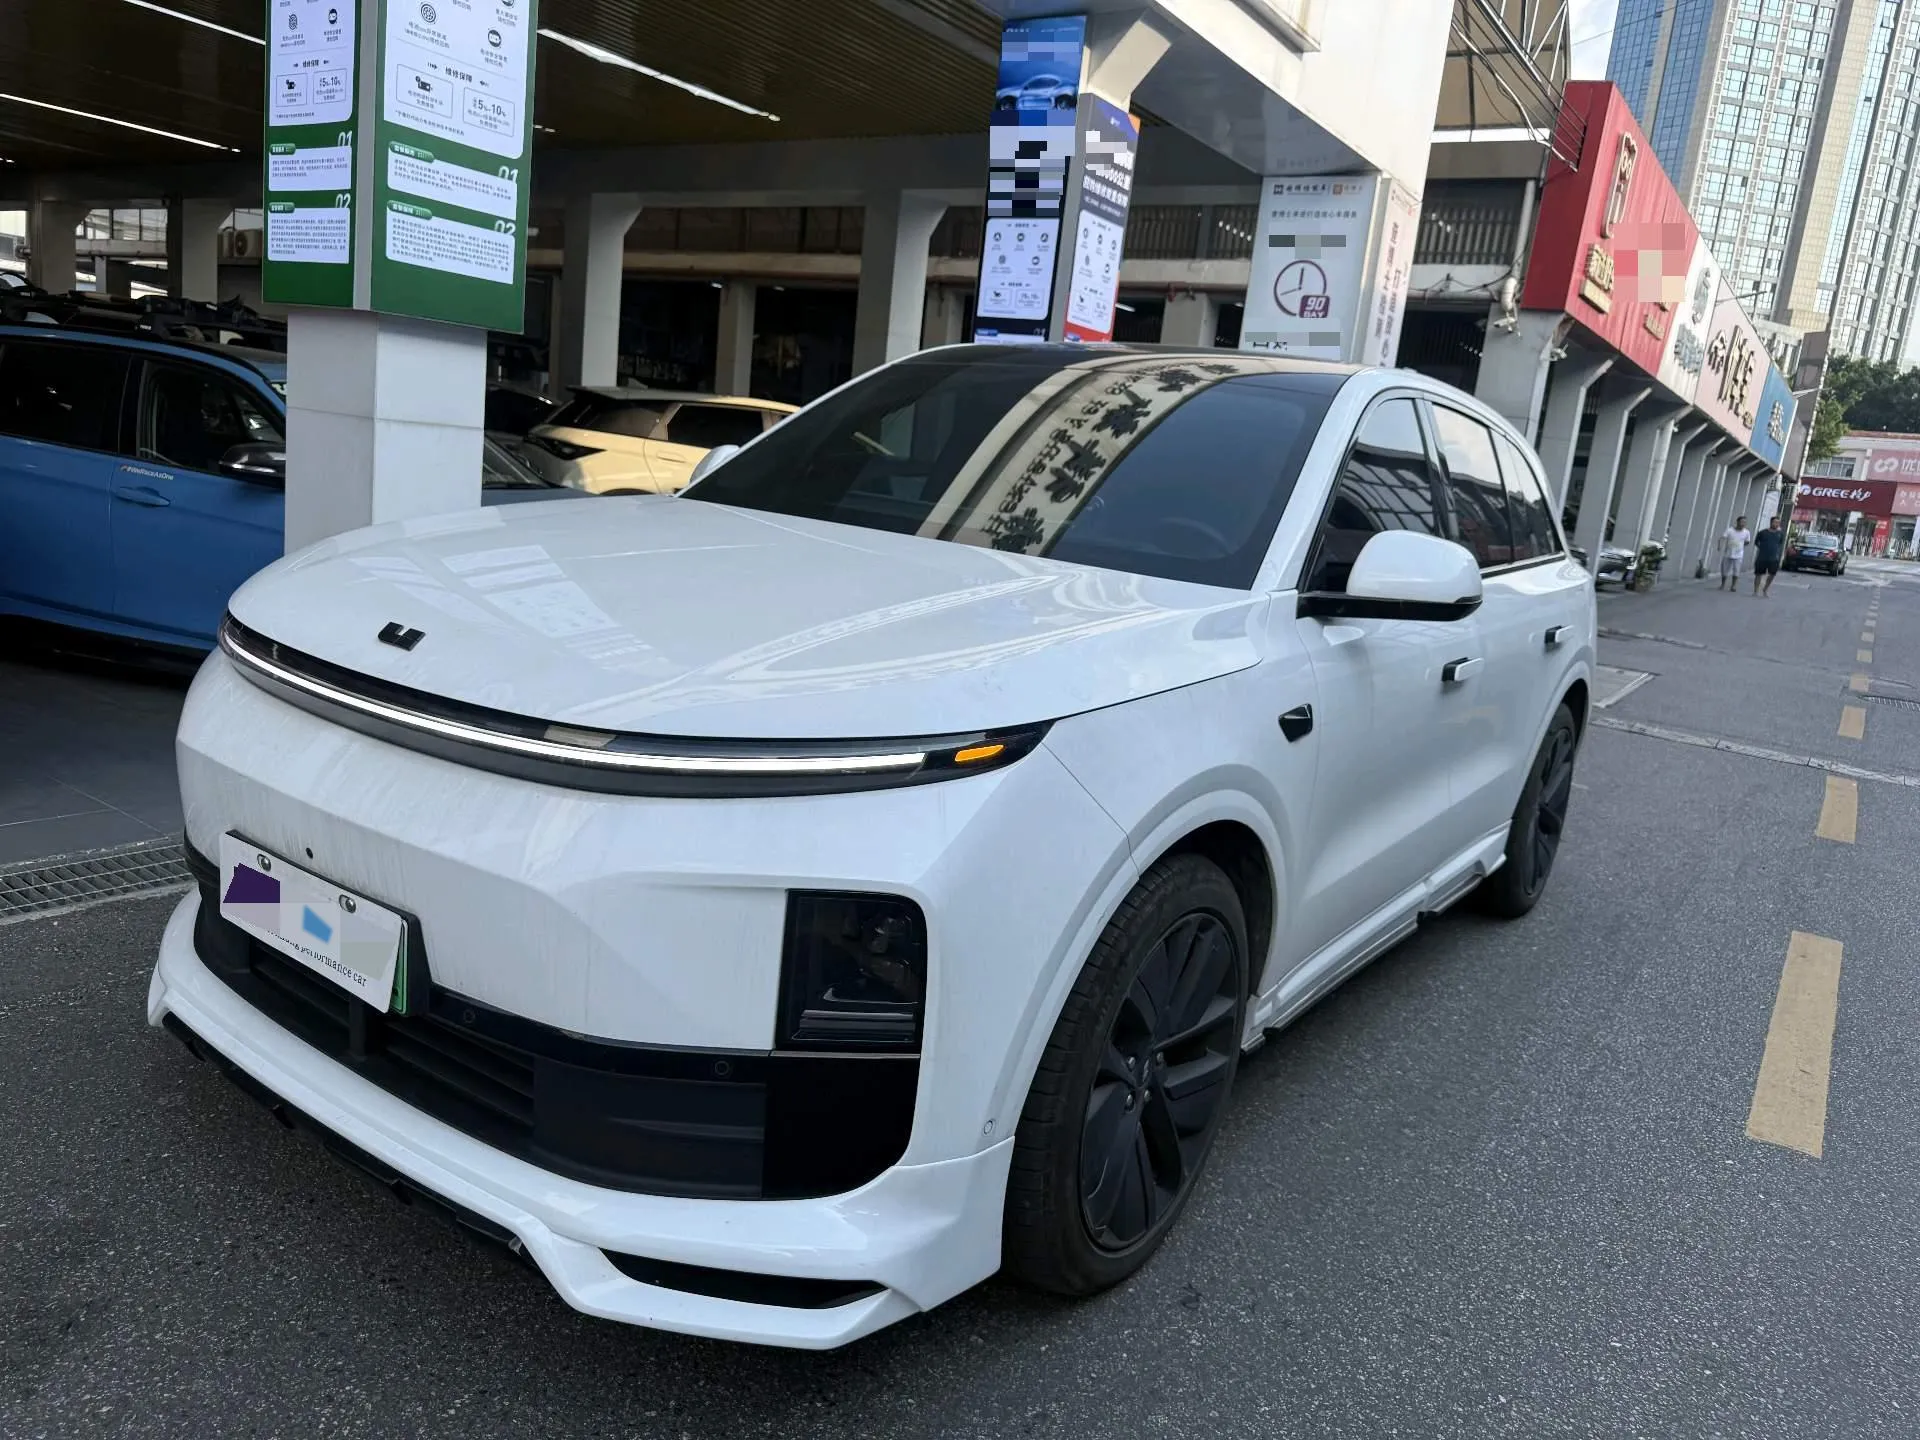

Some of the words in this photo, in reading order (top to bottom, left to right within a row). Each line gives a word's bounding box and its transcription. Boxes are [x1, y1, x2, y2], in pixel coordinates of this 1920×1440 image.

[337, 130, 353, 147] 01
[498, 165, 519, 183] 01
[335, 193, 351, 208] 02
[494, 220, 516, 235] 02
[1305, 296, 1326, 311] 90
[1812, 486, 1850, 499] GREE
[353, 971, 368, 987] car
